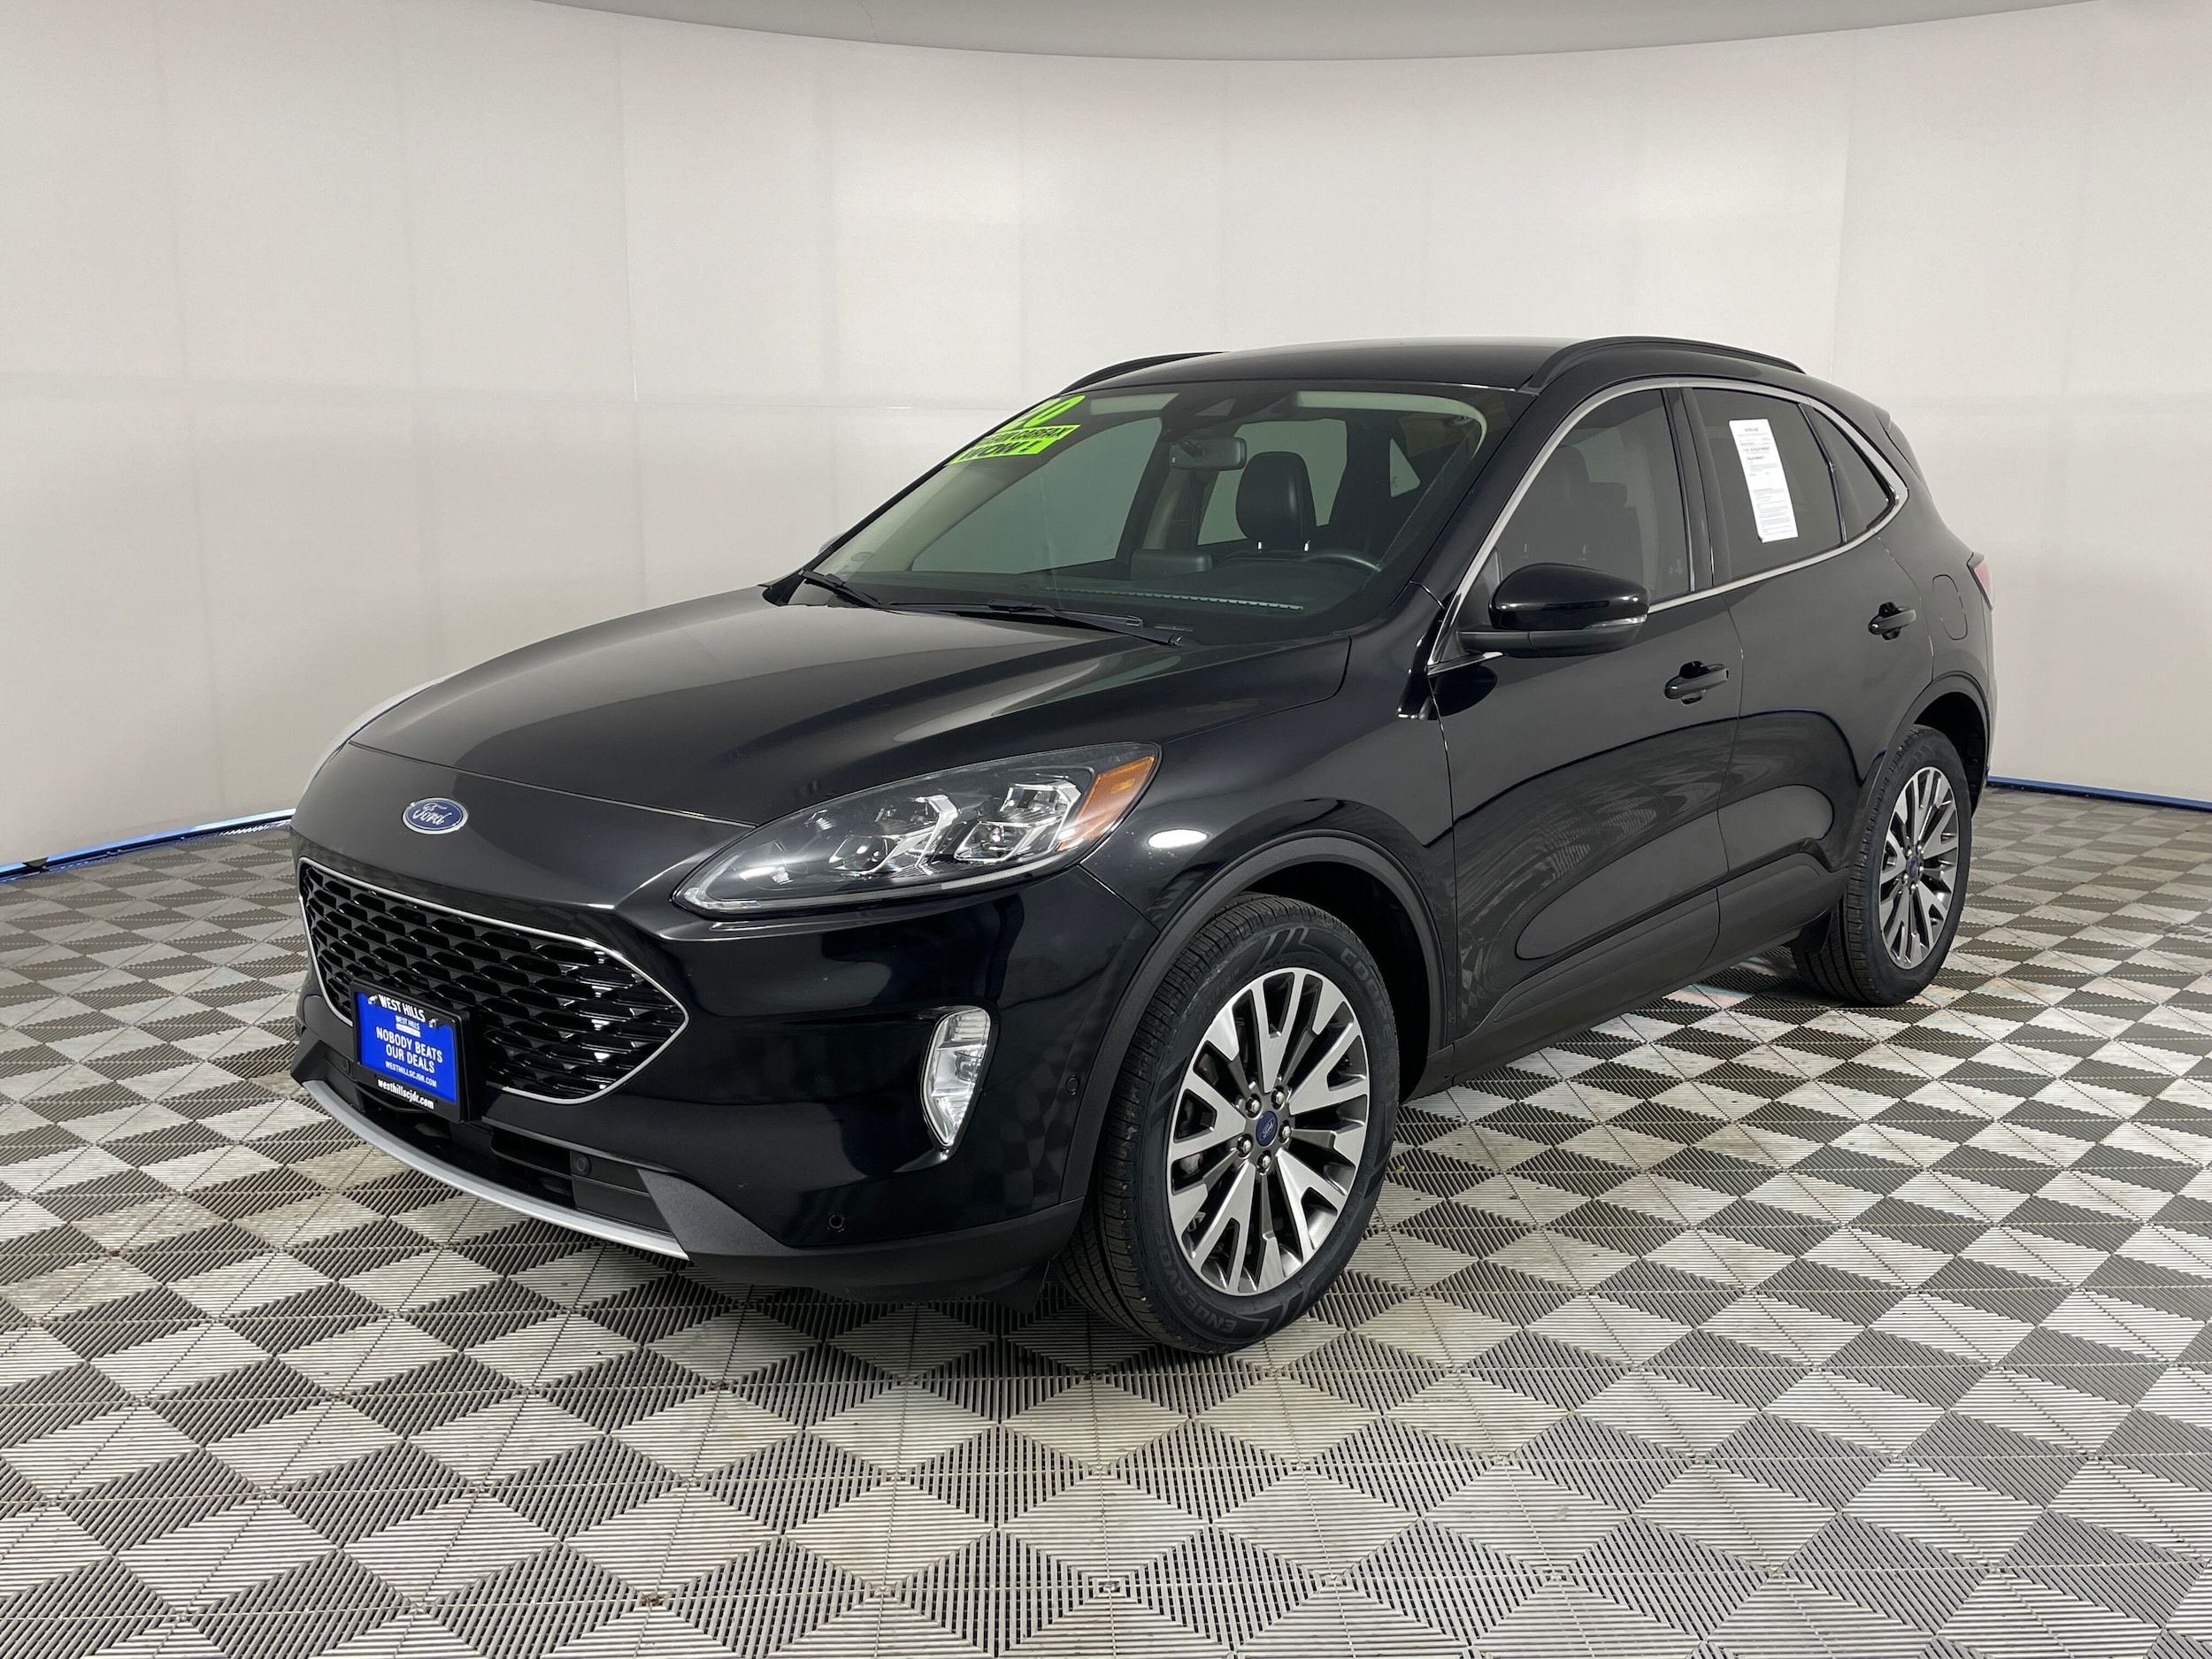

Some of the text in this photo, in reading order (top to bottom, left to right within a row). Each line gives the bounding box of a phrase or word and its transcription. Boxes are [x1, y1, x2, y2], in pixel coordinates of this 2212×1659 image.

[411, 802, 454, 826] Ford
[378, 994, 426, 1023] WEST HILLS
[395, 1015, 407, 1025] WEST
[407, 1018, 420, 1031] HILLS
[376, 1026, 412, 1049] NOBODY
[415, 1041, 443, 1064] BEATS
[386, 1043, 435, 1073] OUR DEALS
[378, 1079, 434, 1110] westhillscjdr.com
